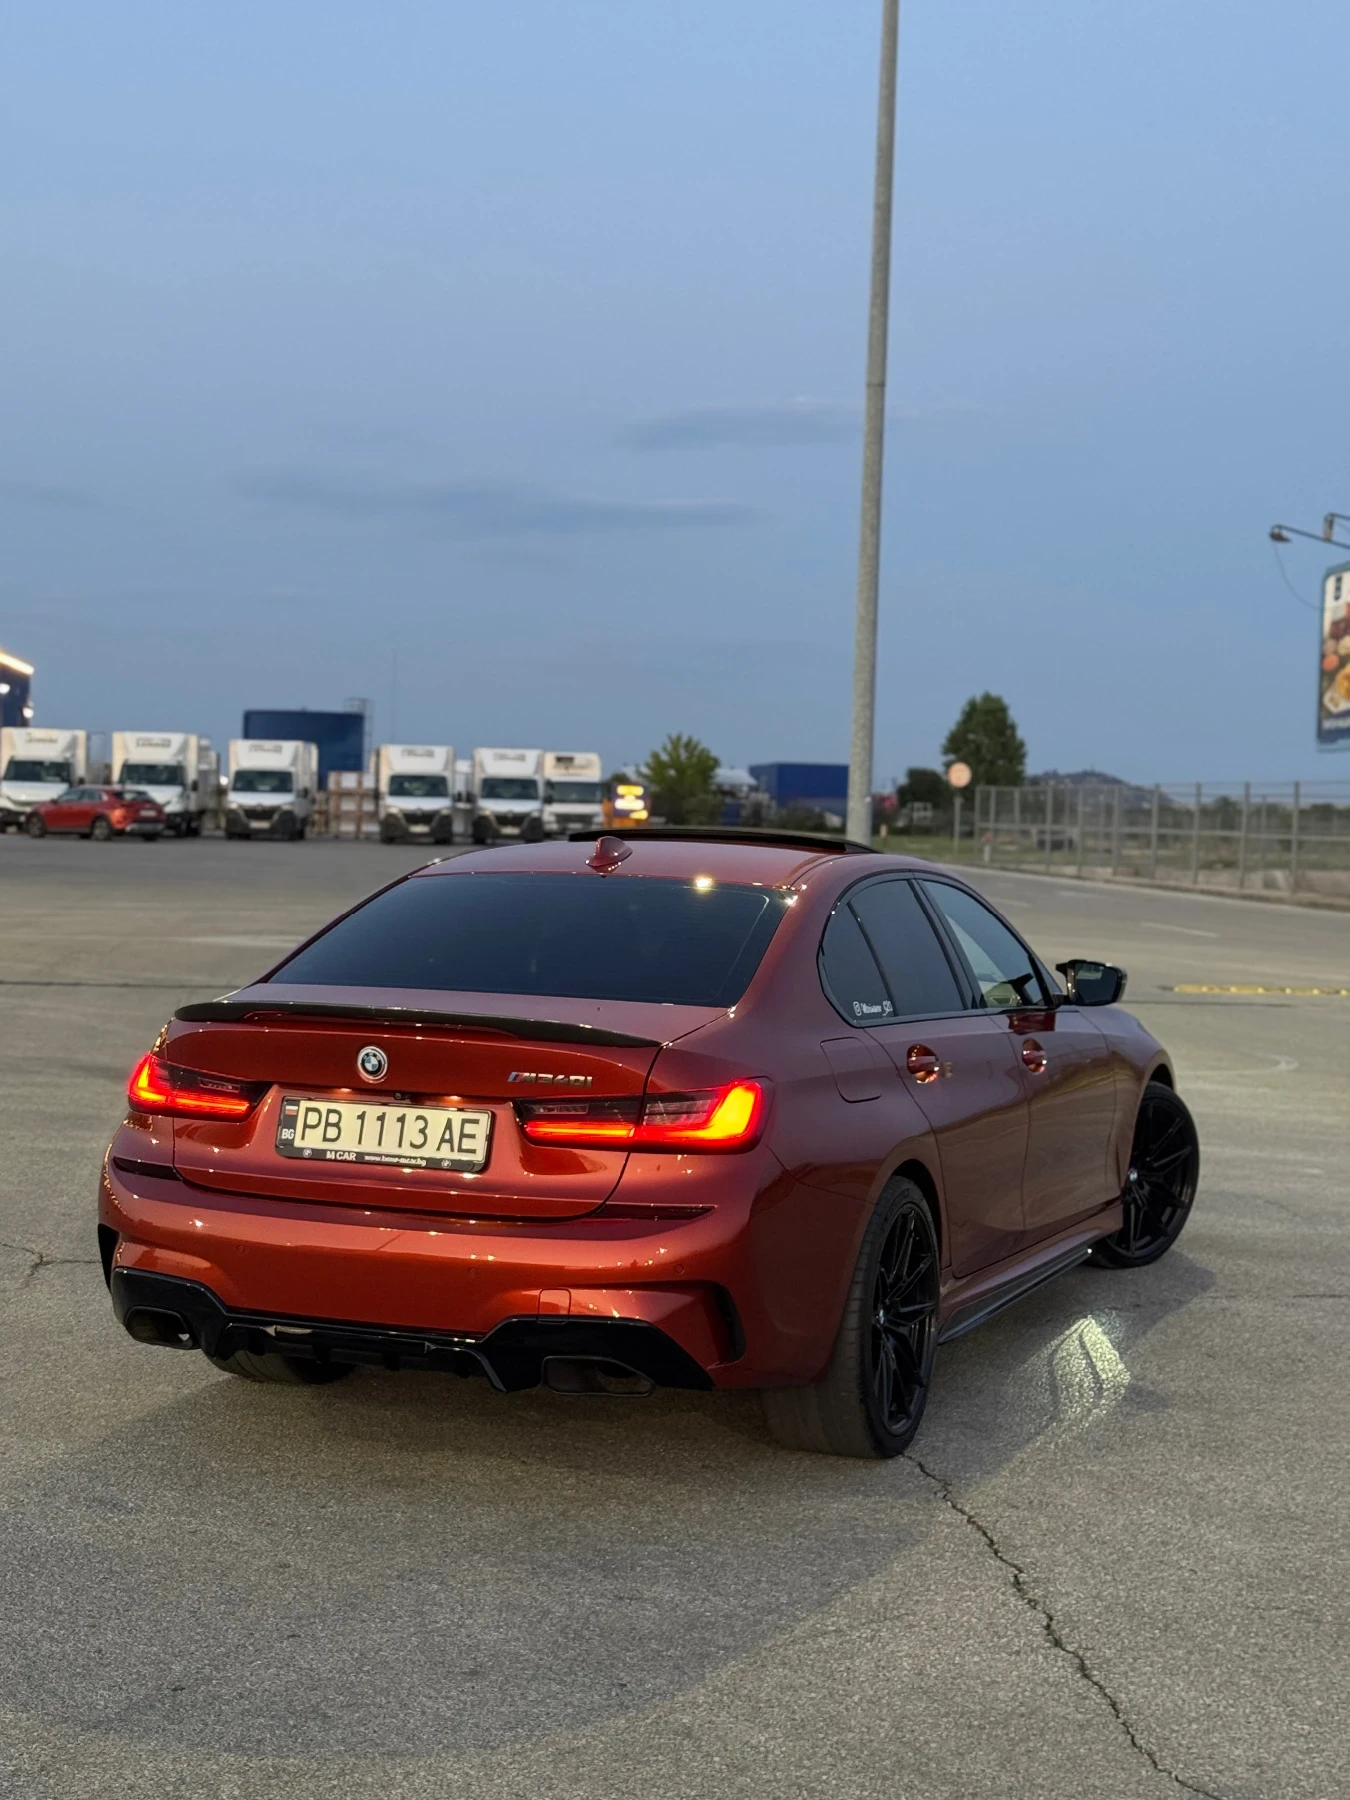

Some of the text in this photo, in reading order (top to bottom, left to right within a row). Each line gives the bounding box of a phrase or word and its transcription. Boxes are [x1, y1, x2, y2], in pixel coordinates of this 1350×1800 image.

[281, 1128, 295, 1140] BG
[300, 1107, 480, 1155] PB 1113 AE
[336, 1151, 356, 1161] CAR
